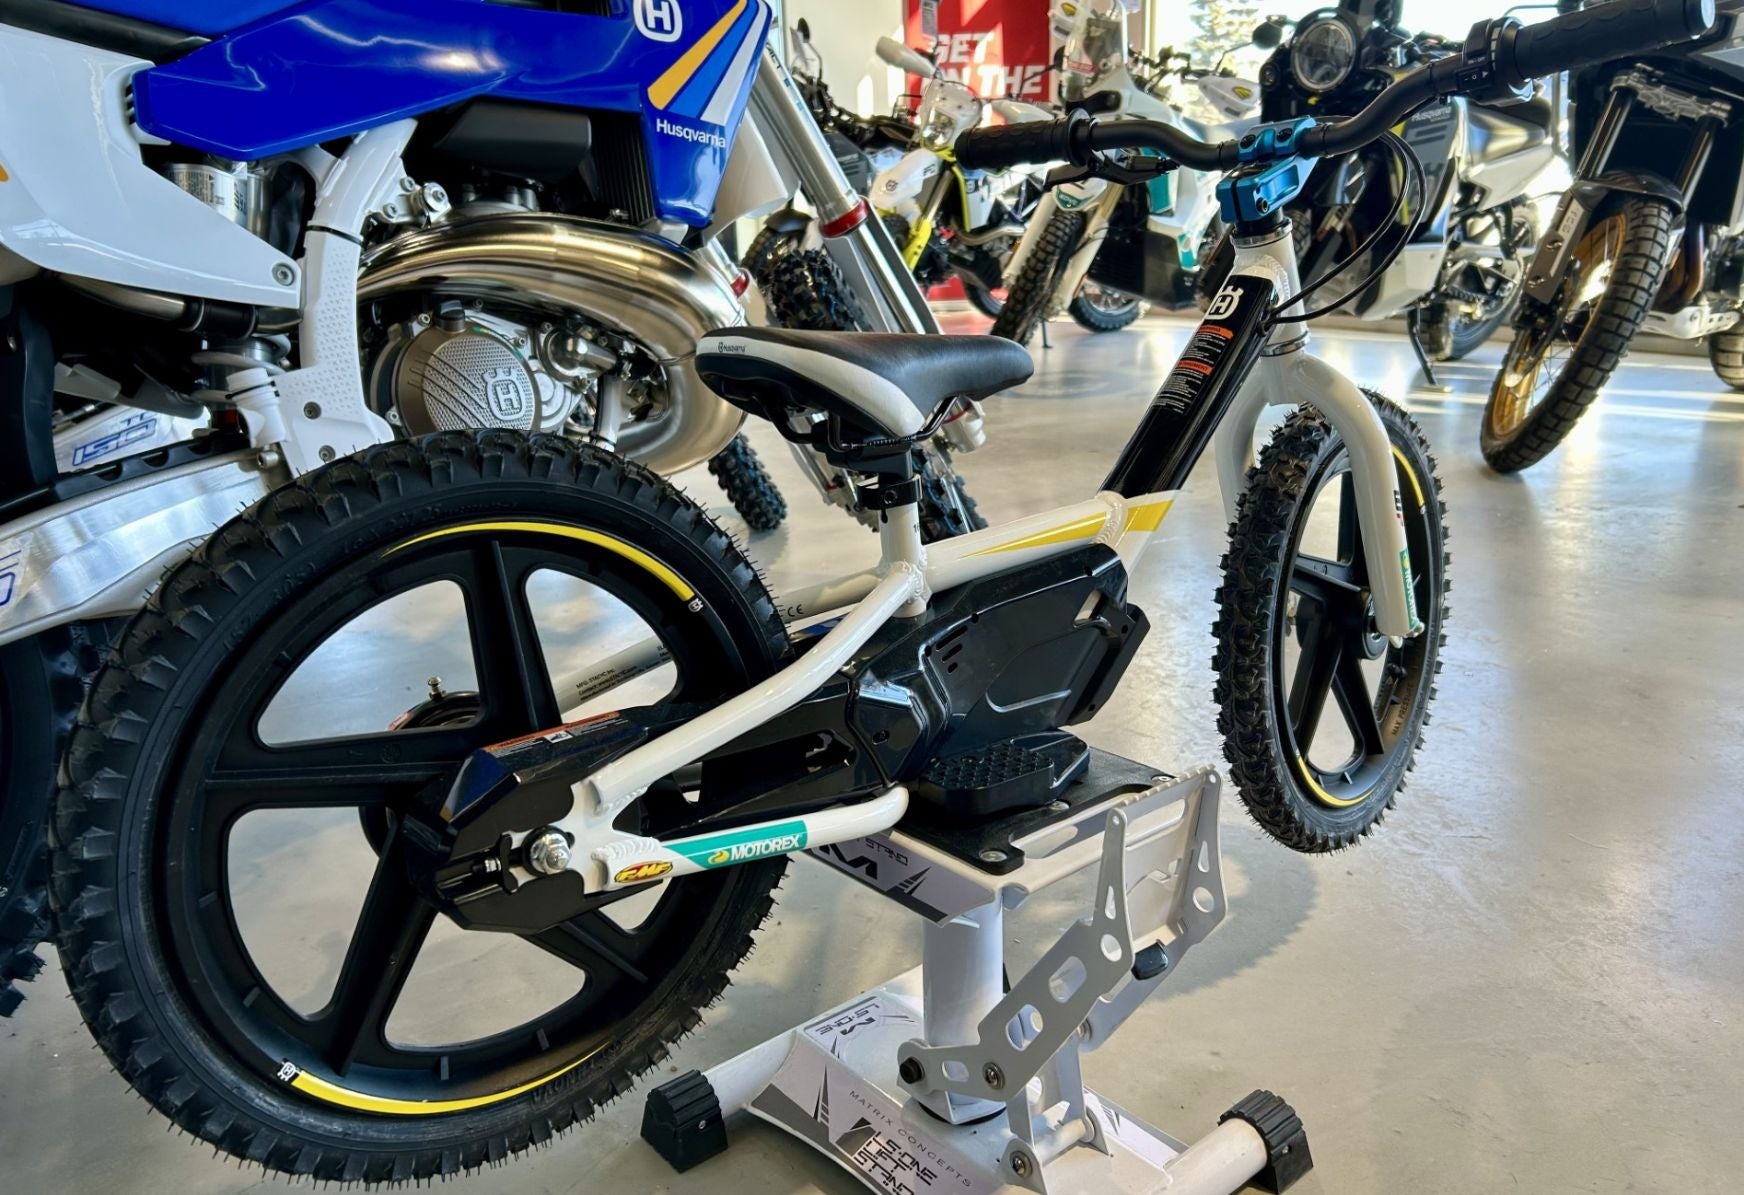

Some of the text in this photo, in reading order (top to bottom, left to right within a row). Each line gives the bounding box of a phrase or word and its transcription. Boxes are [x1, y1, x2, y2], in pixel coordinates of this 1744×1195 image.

[976, 64, 1046, 98] THE
[656, 118, 726, 148] Husqvarna
[72, 418, 157, 466] 150
[787, 603, 804, 617] CE
[730, 834, 801, 861] MOTOREX
[614, 861, 673, 883] FMF
[849, 1090, 972, 1188] MATRIX CONCEPTS
[862, 1140, 907, 1174] LIFT
